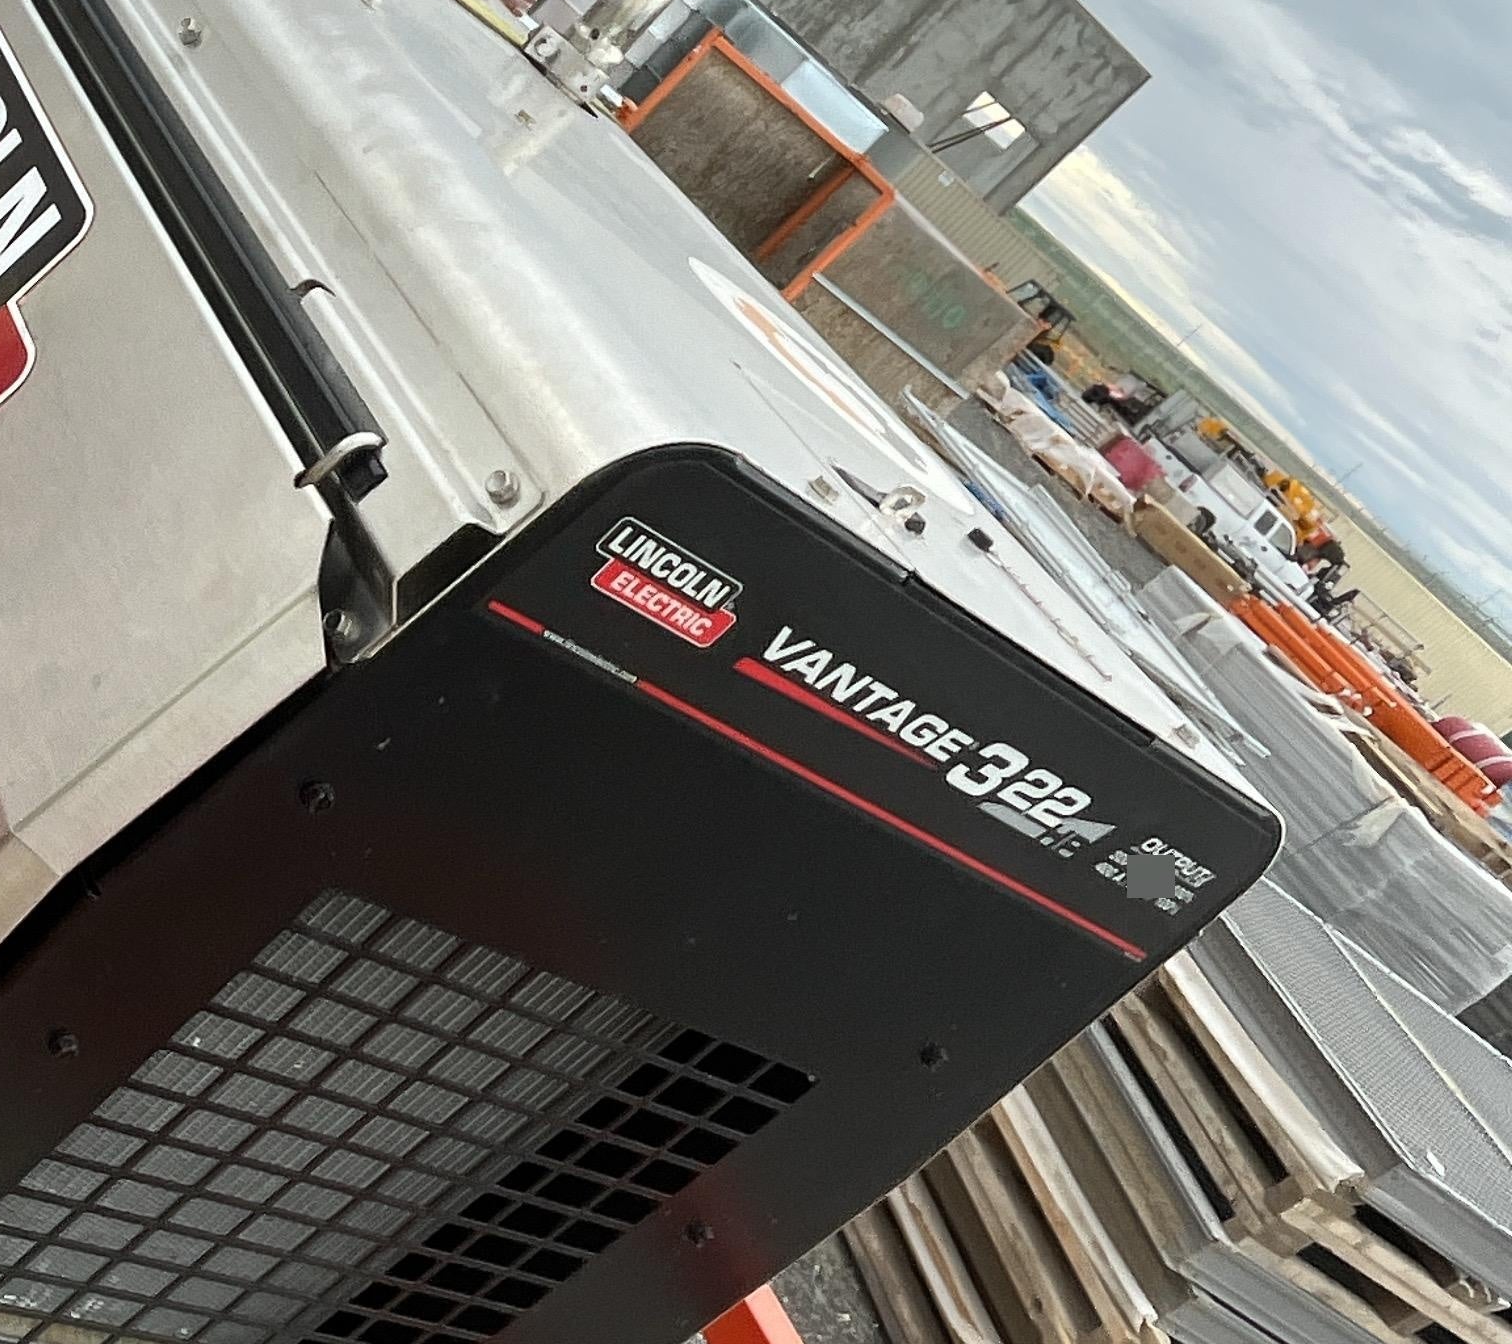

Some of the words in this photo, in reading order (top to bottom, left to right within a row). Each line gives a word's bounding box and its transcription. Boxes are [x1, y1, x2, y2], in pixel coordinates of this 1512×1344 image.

[607, 525, 731, 609] LINCOLN
[610, 569, 714, 638] ELECTRIC
[762, 624, 975, 763] VANTAGE
[945, 741, 1093, 825] 322
